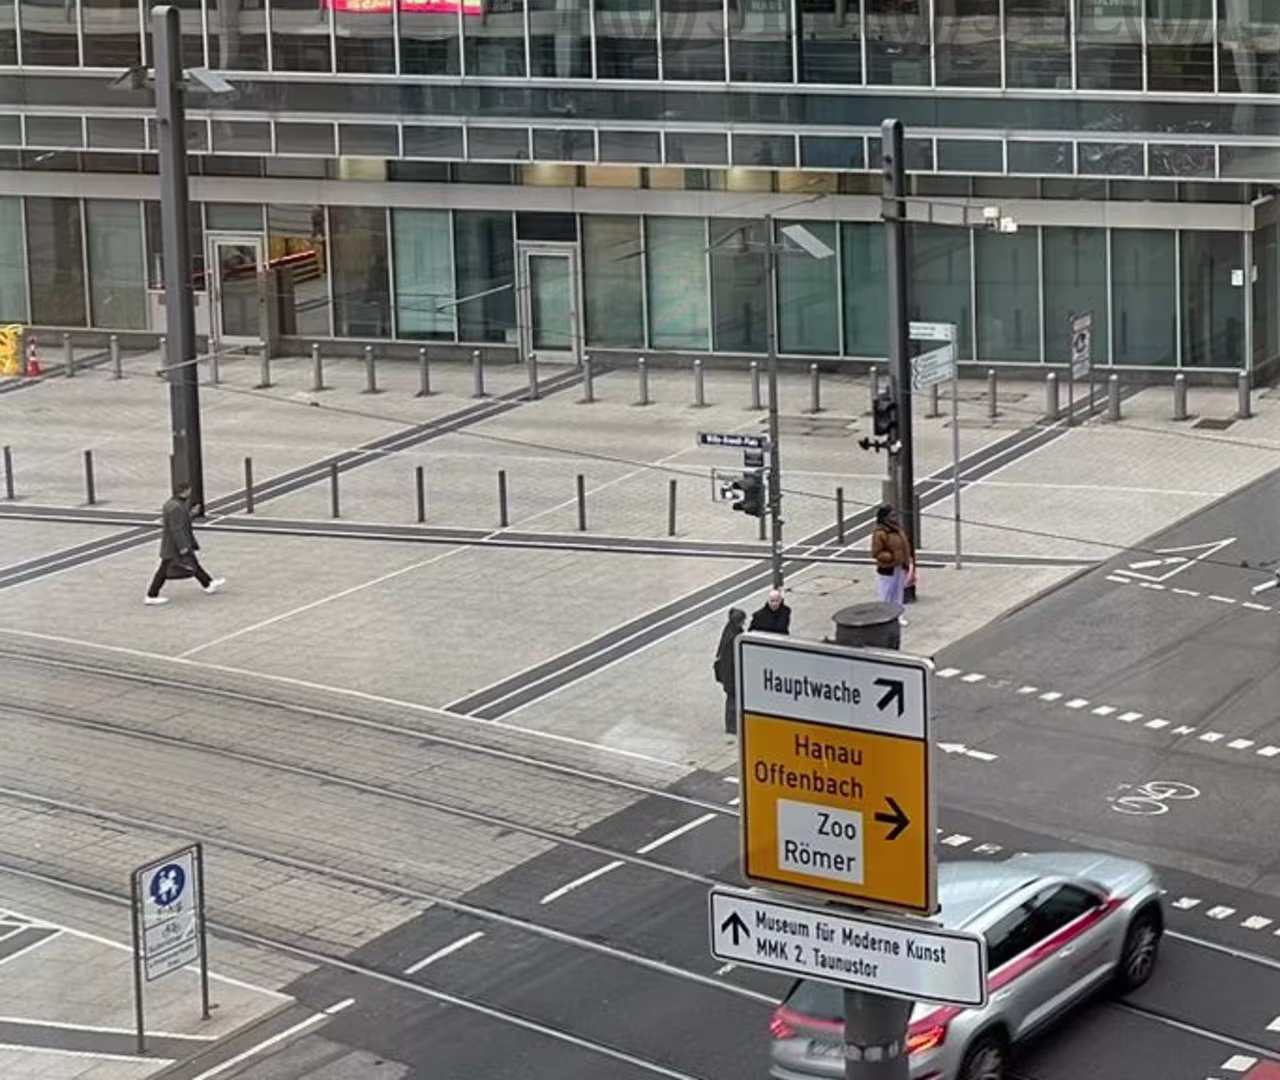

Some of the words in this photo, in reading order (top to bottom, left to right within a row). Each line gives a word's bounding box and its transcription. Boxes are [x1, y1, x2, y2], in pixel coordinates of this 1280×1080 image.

[763, 668, 862, 705] Hauptwache
[794, 733, 863, 766] Hanau
[754, 760, 863, 799] Offenbach
[816, 812, 857, 840] Zoo
[784, 839, 857, 873] Römer
[755, 910, 810, 938] Museum
[815, 921, 836, 943] für
[841, 926, 900, 956] Moderne
[906, 938, 947, 965] Kunst
[756, 937, 789, 961] MMK
[794, 944, 807, 965] 2.
[813, 947, 880, 978] Taunustor
